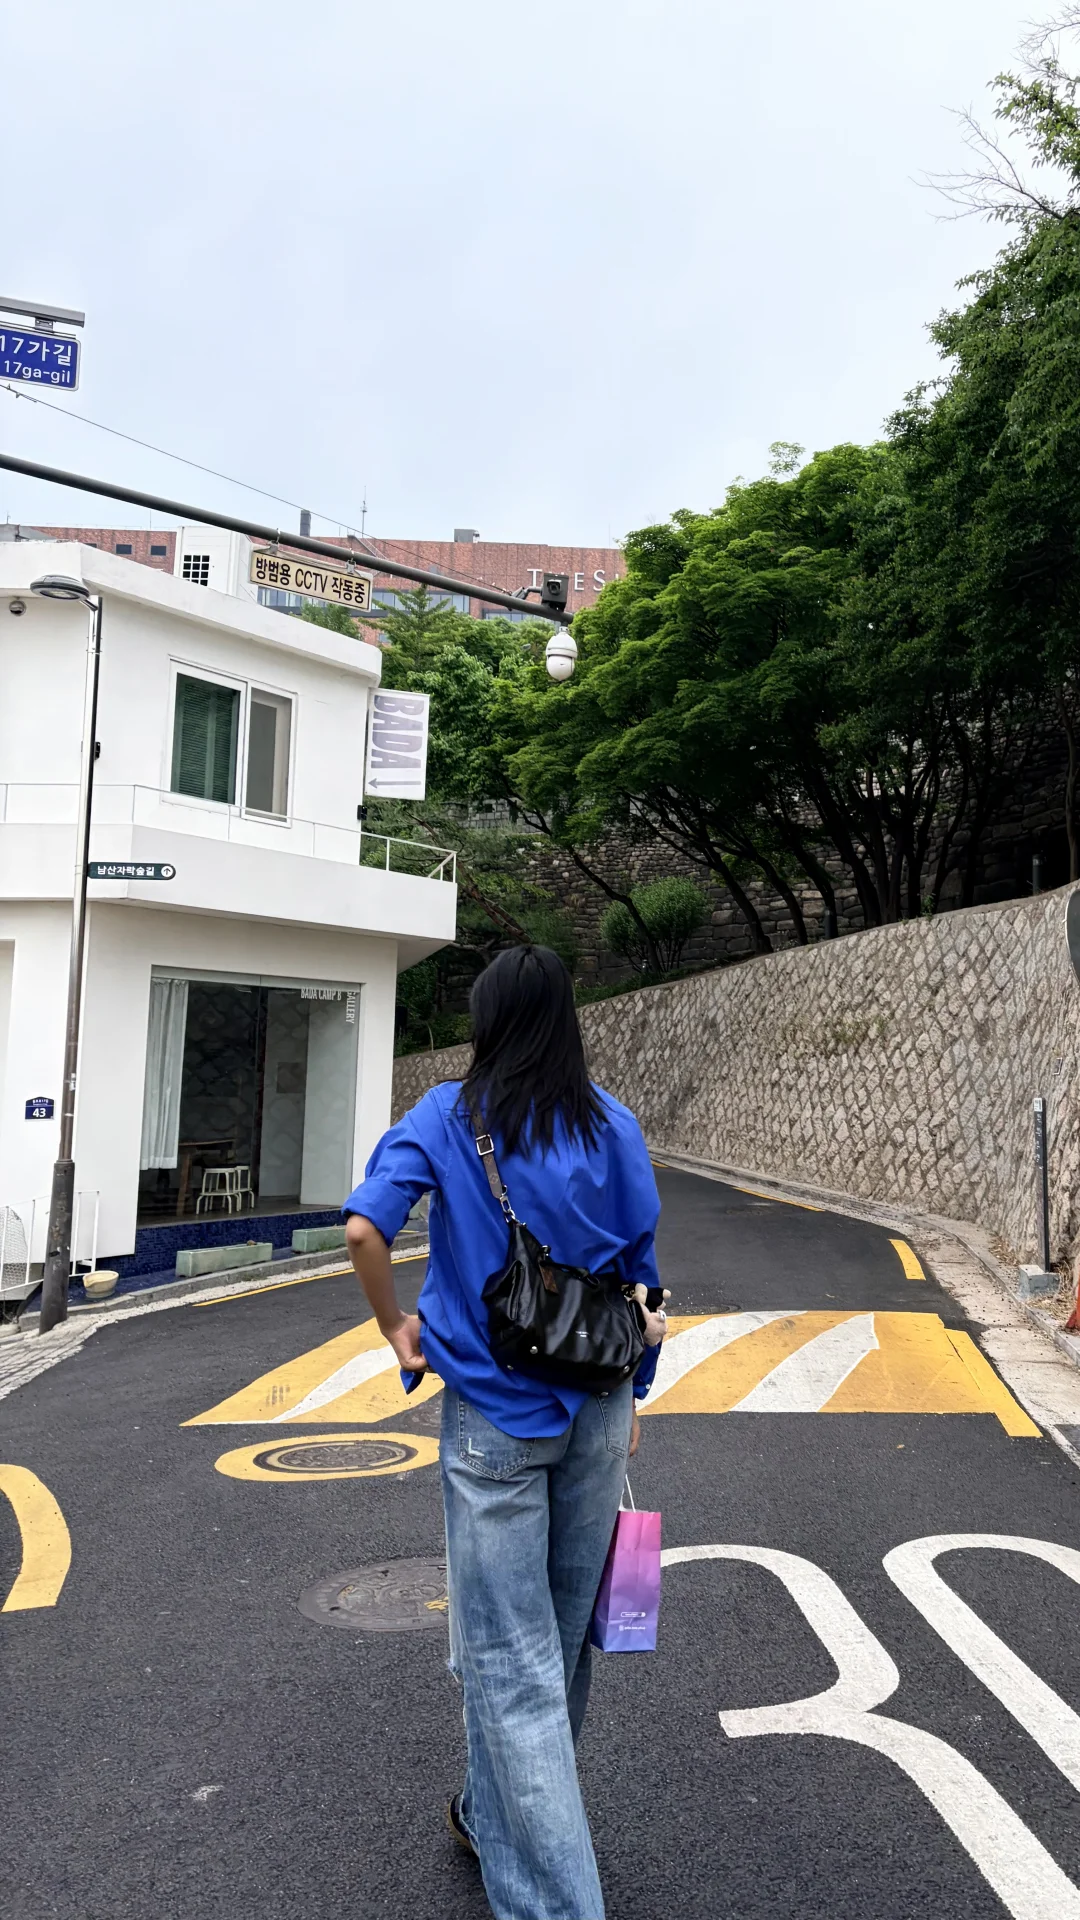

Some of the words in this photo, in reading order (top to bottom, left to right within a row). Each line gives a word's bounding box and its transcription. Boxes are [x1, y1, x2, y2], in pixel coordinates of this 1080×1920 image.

[4, 360, 70, 383] 17ga-gil
[256, 557, 291, 586] 방범용
[295, 568, 328, 593] CCTV
[331, 576, 366, 604] 작동중
[370, 694, 425, 769] BADA
[97, 865, 155, 877] 남산자락숲길
[319, 988, 336, 1001] CAMP
[345, 991, 356, 1024] GALLERY
[32, 1107, 47, 1118] 43
